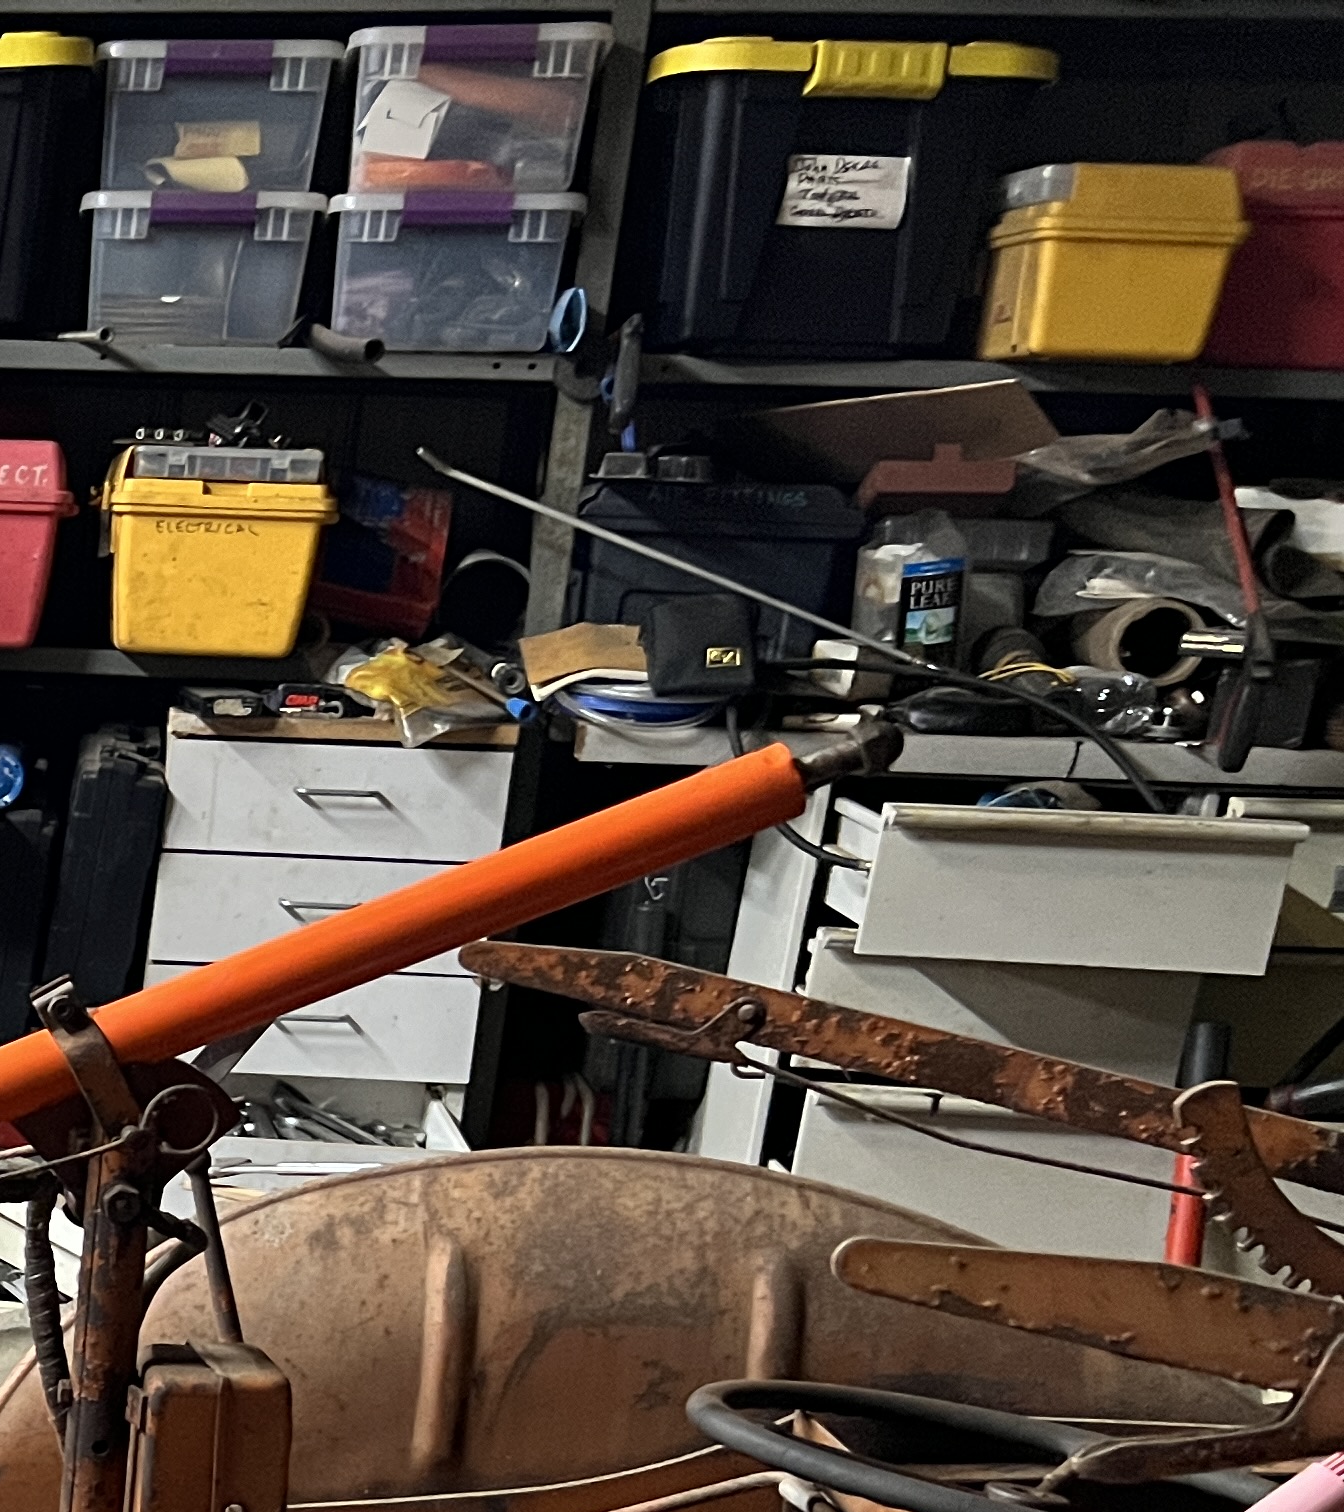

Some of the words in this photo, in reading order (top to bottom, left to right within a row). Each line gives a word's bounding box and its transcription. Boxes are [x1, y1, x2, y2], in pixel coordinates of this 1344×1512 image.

[155, 519, 262, 537] ELECTRICAL
[910, 578, 954, 596] PURE
[909, 592, 952, 610] LEAF
